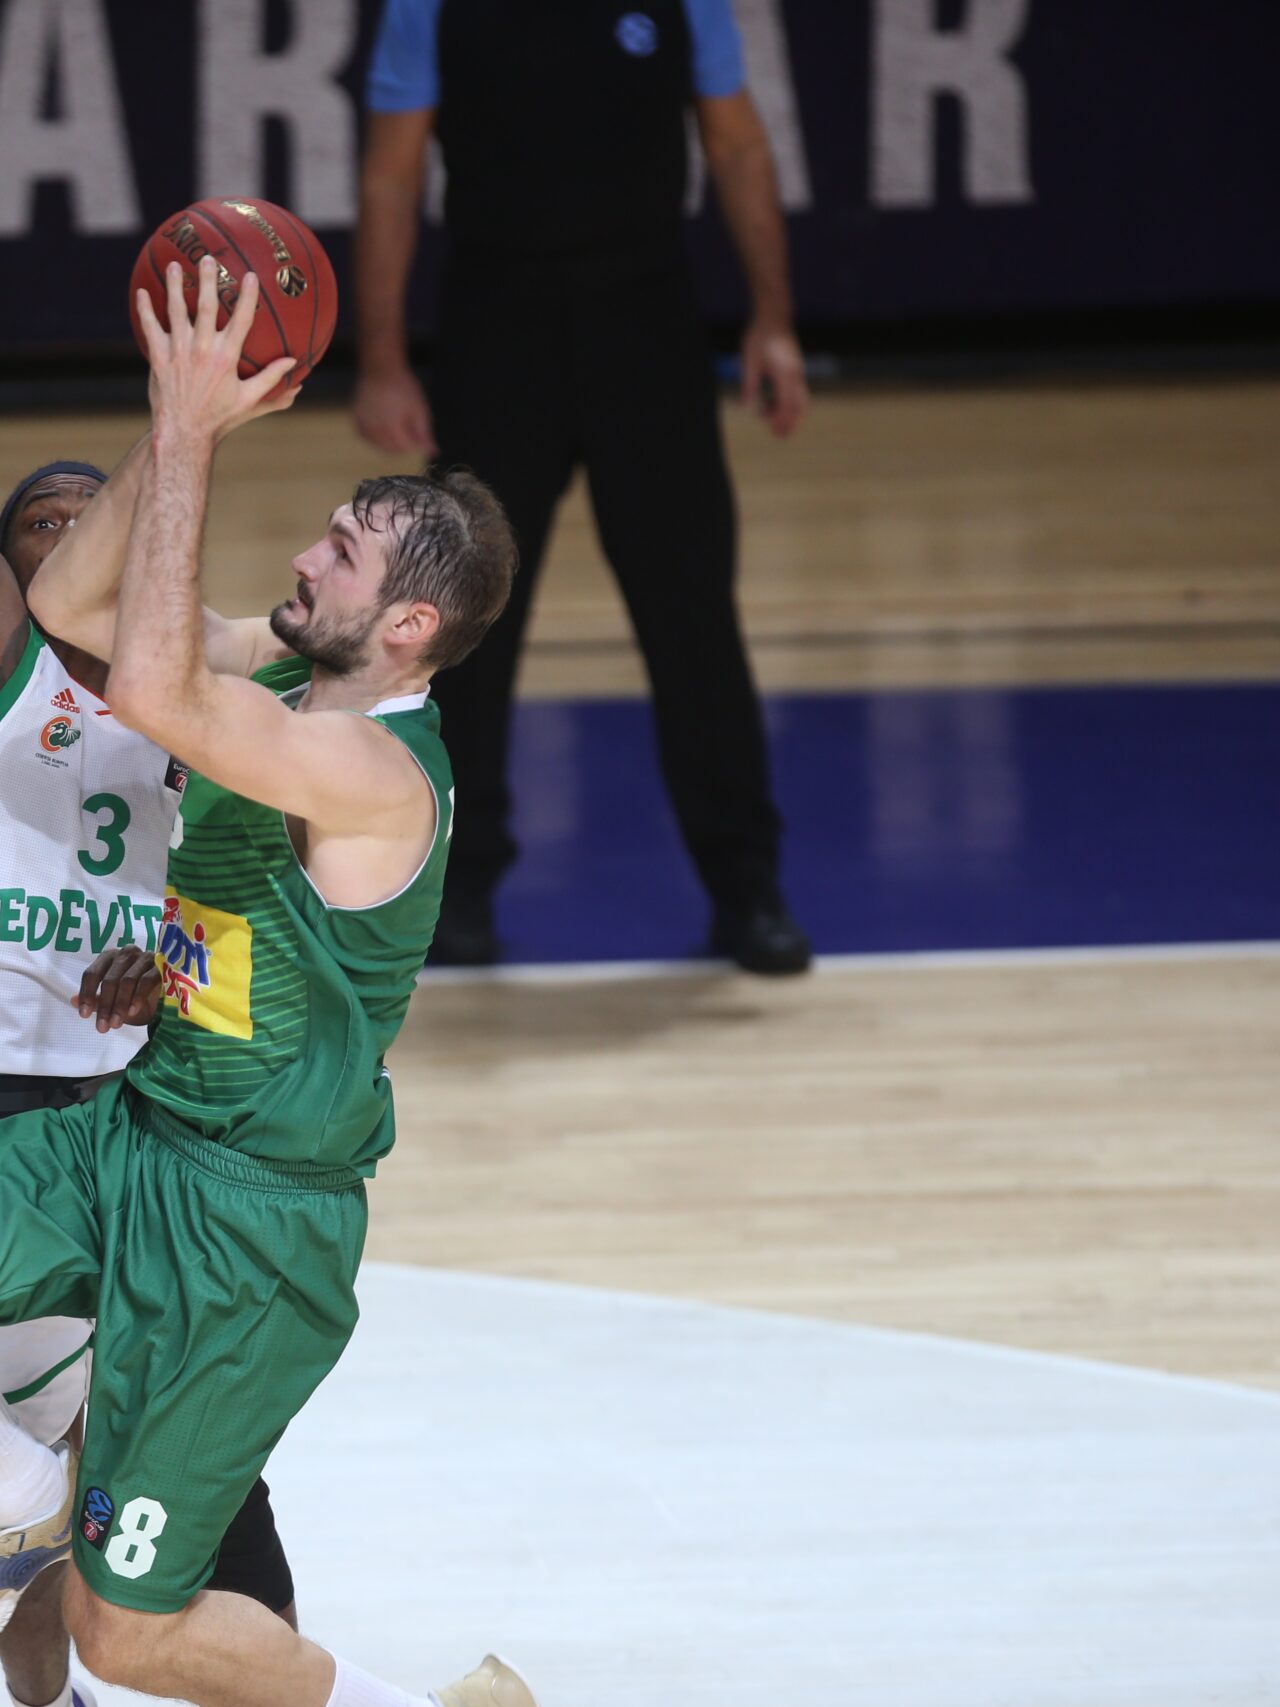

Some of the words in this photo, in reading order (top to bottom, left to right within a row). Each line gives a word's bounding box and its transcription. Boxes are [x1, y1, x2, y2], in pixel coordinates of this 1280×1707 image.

[50, 699, 81, 714] adidas
[77, 792, 132, 877] 3
[104, 1496, 168, 1580] 8
